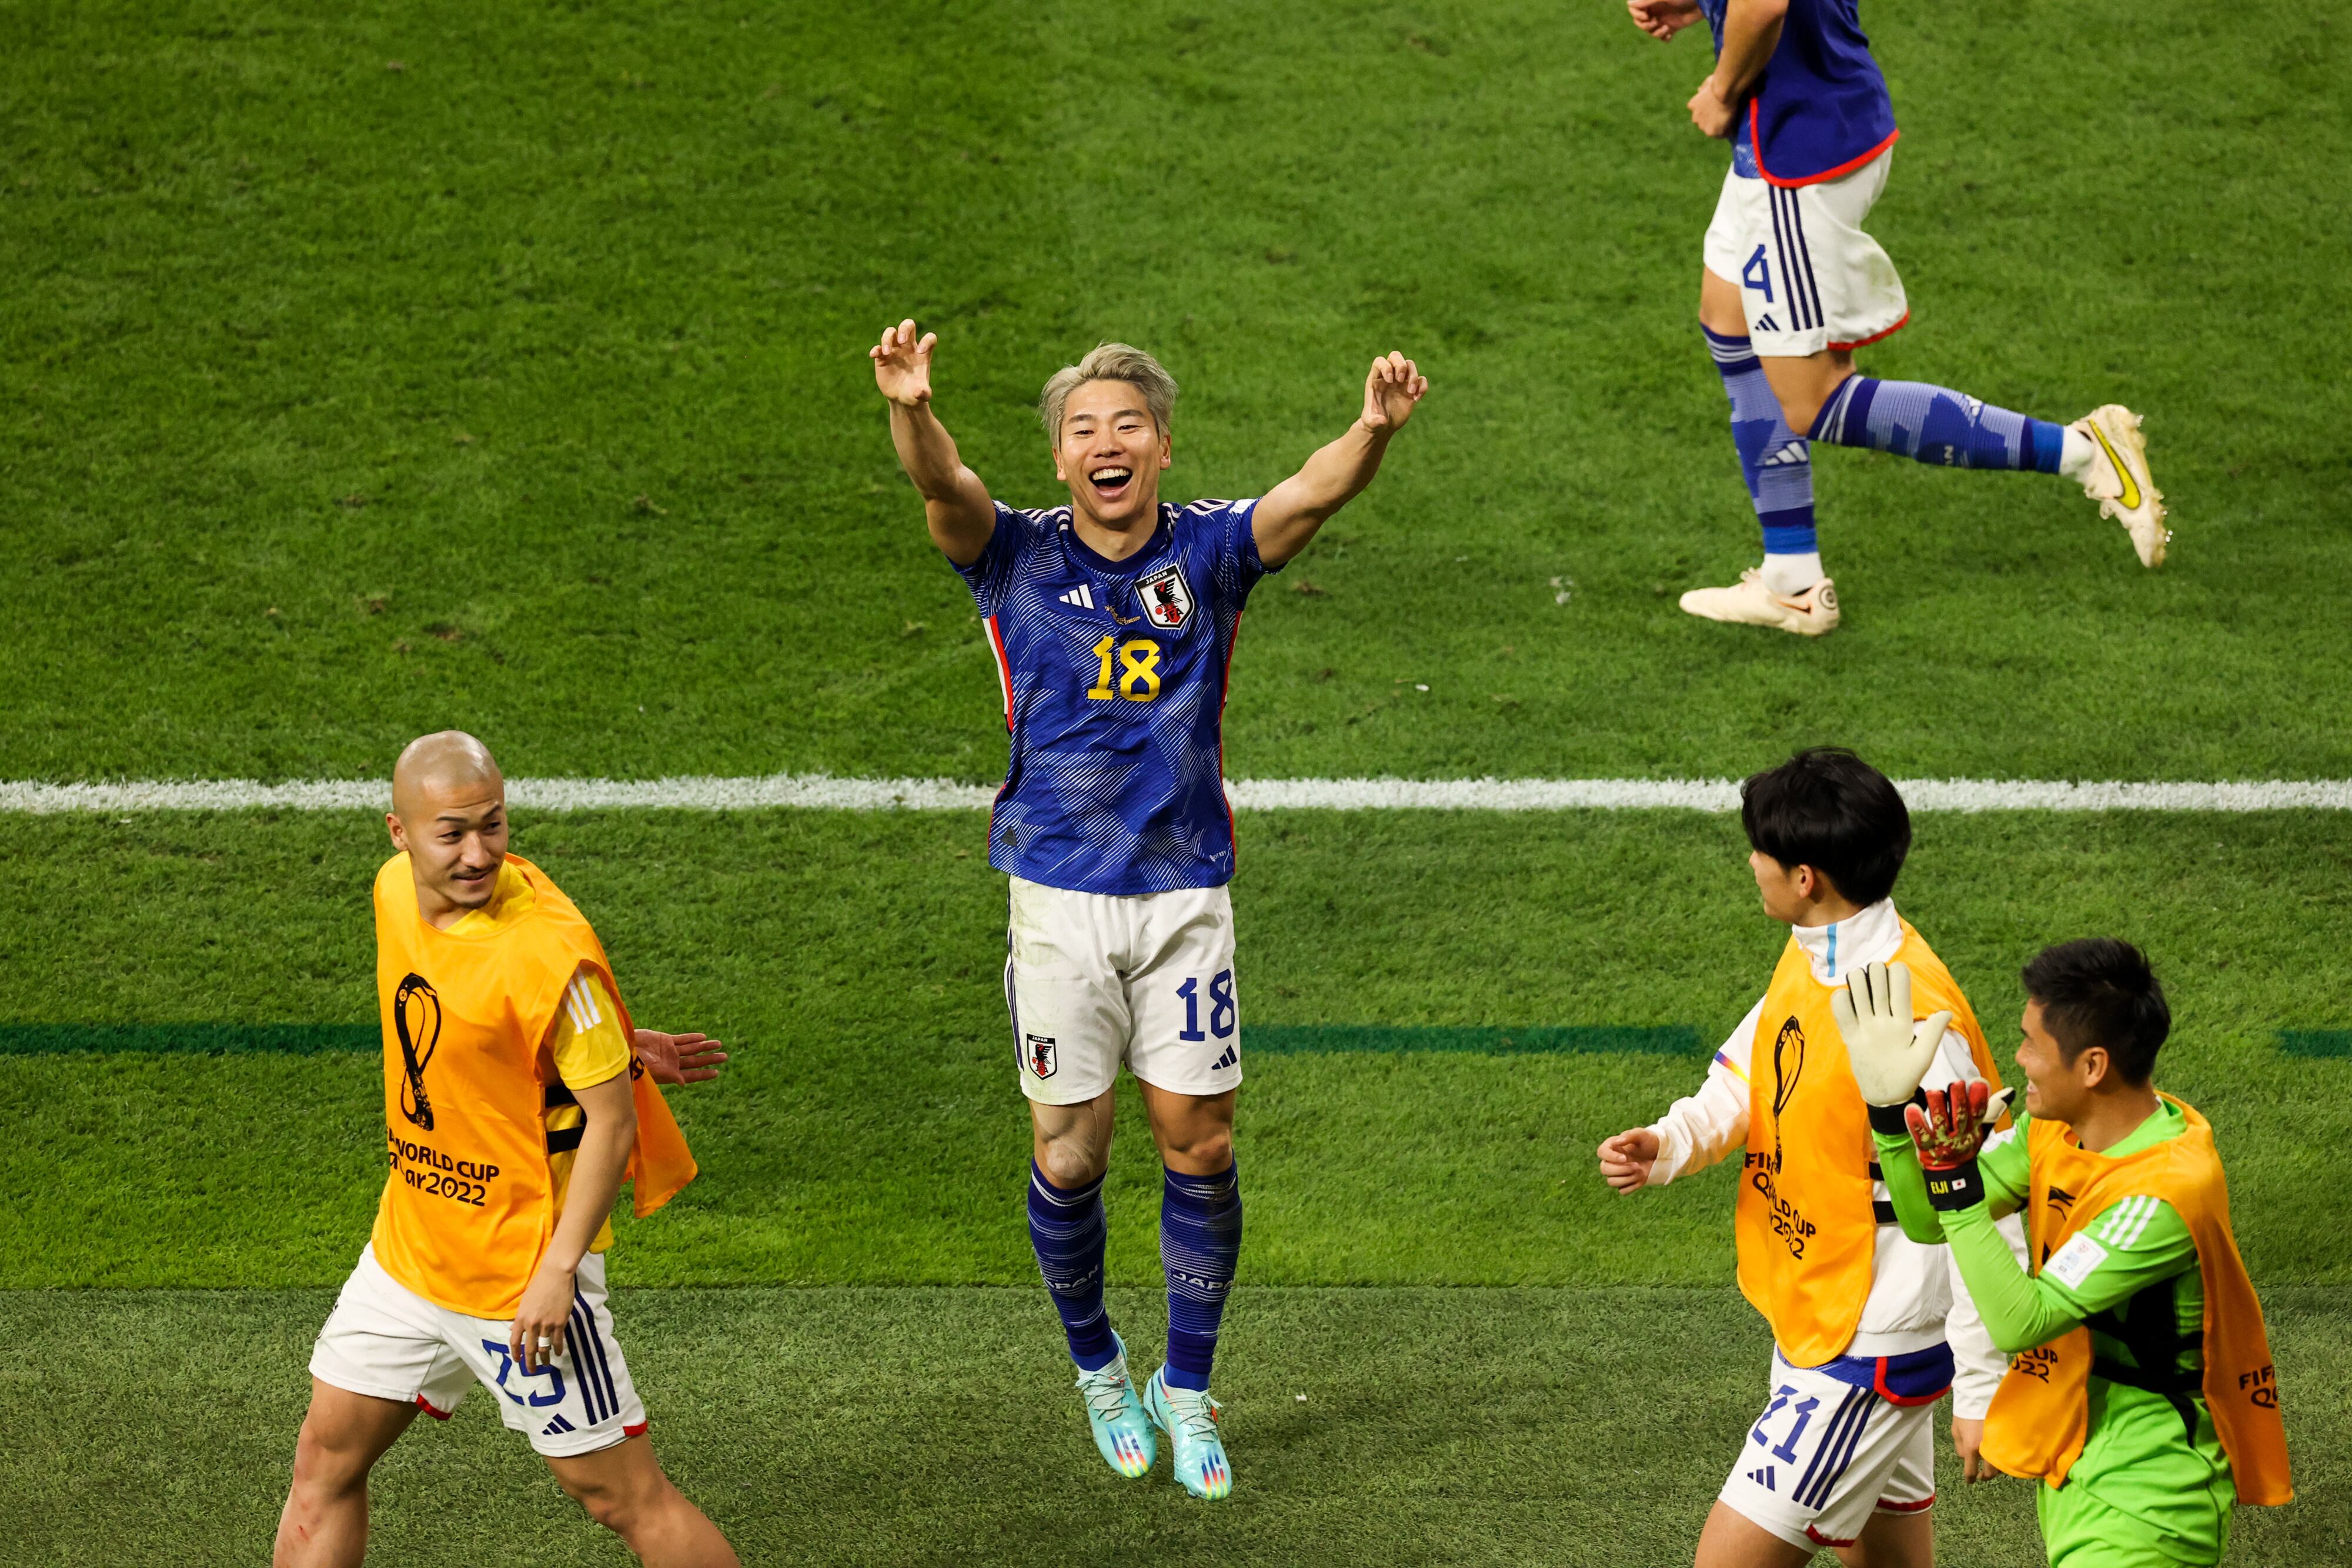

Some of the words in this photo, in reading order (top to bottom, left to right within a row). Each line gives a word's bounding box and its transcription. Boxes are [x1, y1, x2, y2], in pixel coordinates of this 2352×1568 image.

[1742, 244, 1773, 303] 4
[1145, 571, 1168, 584] JAPAN
[1124, 616, 1141, 625] STADIUM
[1164, 607, 1184, 623] JFA
[1087, 636, 1161, 702] 18
[1175, 968, 1235, 1041] 18
[456, 1161, 500, 1182] CUP
[1930, 1180, 1949, 1195] EIJI
[482, 1339, 566, 1407] 25
[2239, 1364, 2275, 1390] FIF
[1752, 1384, 1820, 1465] 21
